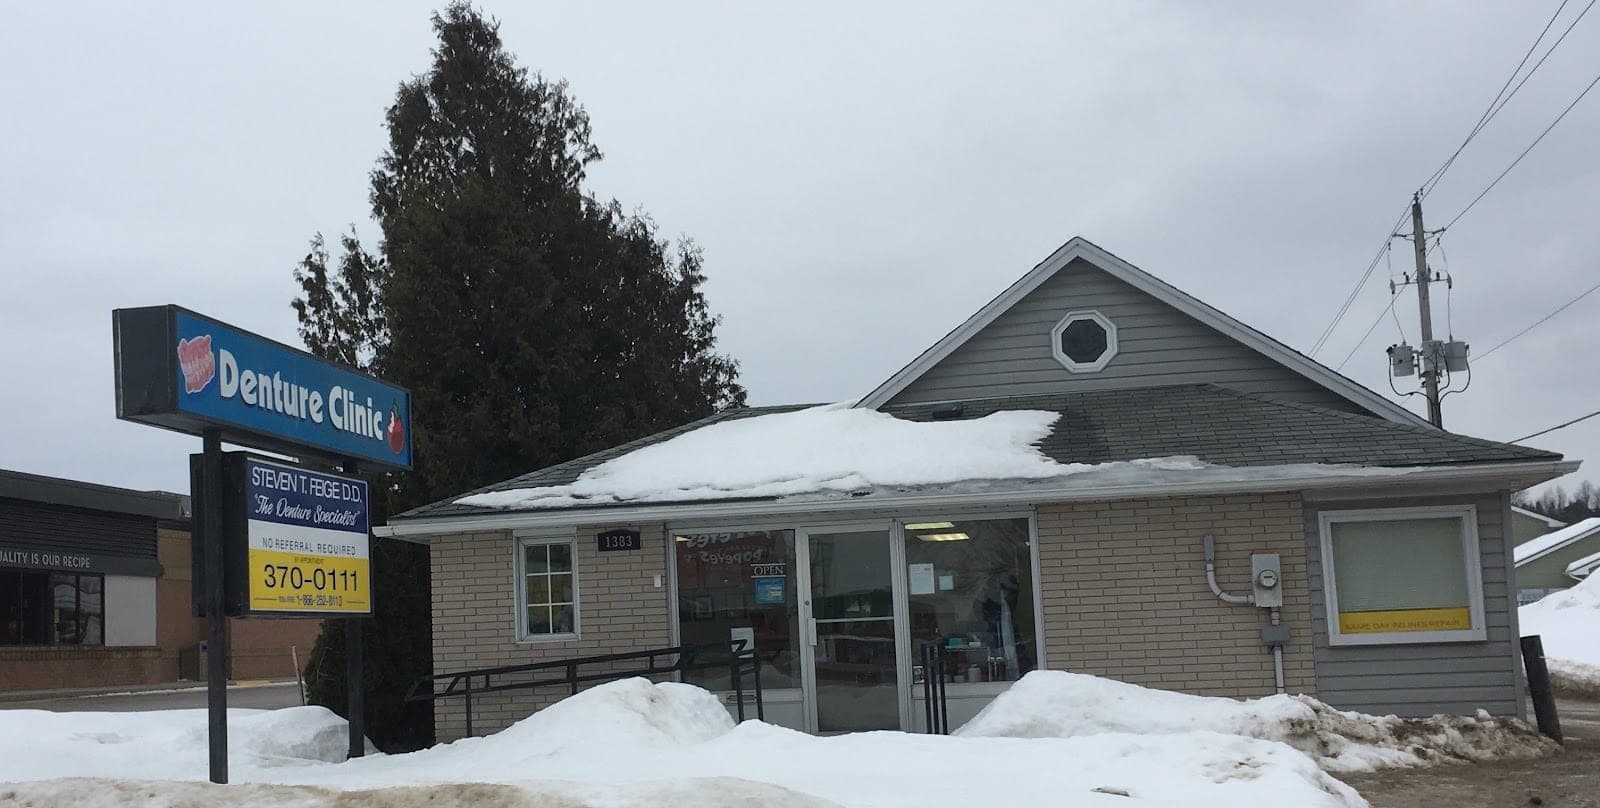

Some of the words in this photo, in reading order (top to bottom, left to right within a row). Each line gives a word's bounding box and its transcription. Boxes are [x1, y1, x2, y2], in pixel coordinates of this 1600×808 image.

[219, 348, 324, 424] Denture
[328, 385, 384, 441] Clinic
[252, 466, 298, 492] STEVEN
[299, 475, 308, 494] T.
[309, 478, 340, 499] FEIGE
[342, 483, 362, 503] D.D.
[276, 498, 312, 520] Denture
[263, 538, 273, 548] NO
[275, 539, 314, 552] REFERRAL
[317, 543, 356, 556] REQUIRED
[605, 535, 632, 548] 1383
[31, 553, 39, 565] IS
[42, 554, 60, 566] OUR
[63, 555, 91, 568] RECIPE
[264, 564, 357, 591] 370-0111
[754, 566, 784, 576] OPEN
